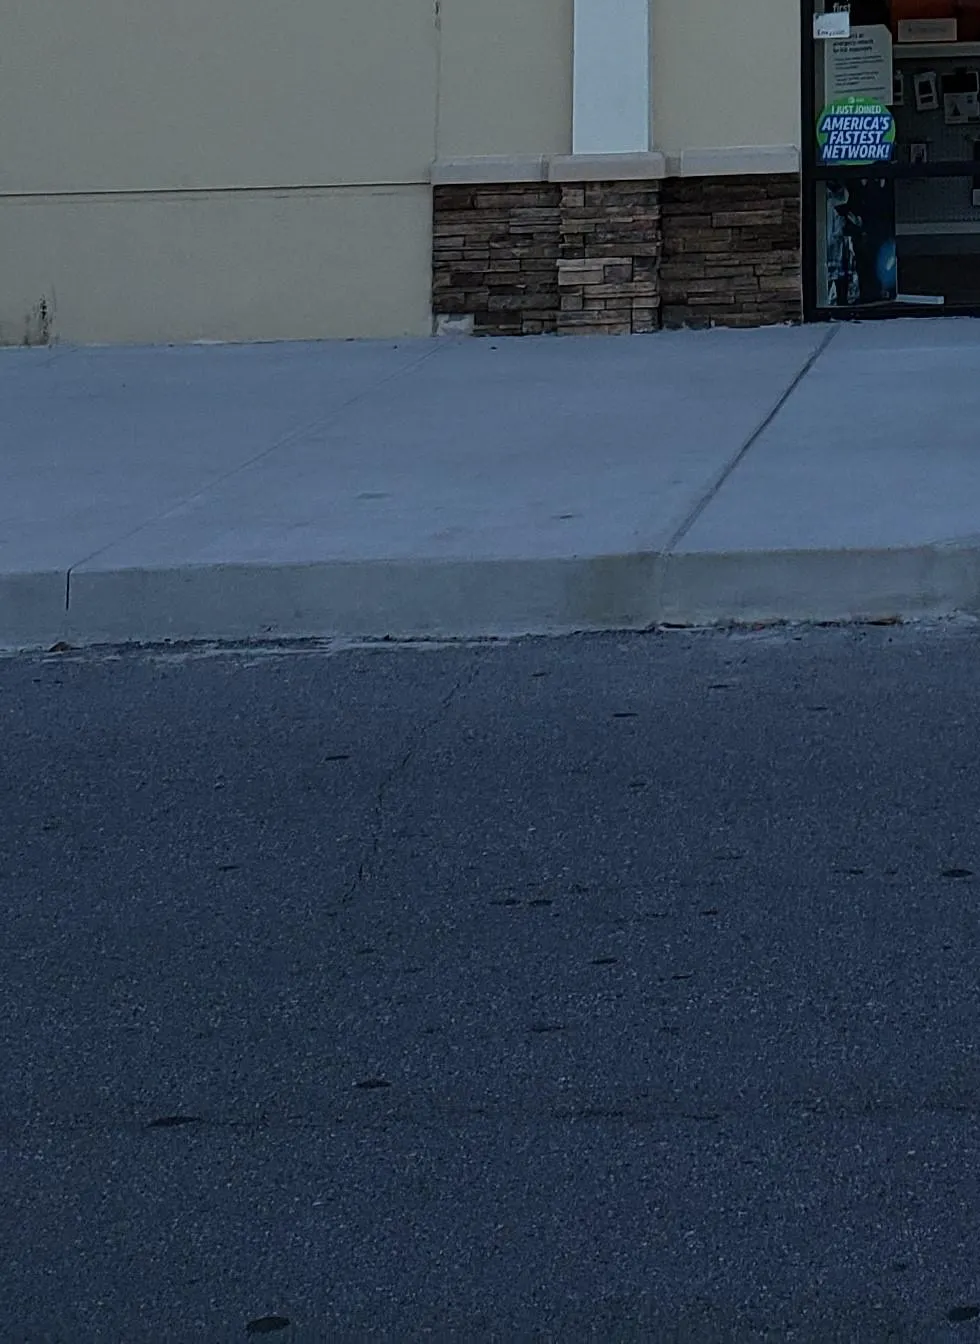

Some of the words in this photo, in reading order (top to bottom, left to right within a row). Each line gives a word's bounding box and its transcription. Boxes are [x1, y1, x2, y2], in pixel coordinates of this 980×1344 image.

[833, 2, 852, 12] first
[836, 105, 853, 114] JUST
[854, 105, 881, 114] JOINED
[821, 116, 890, 131] AMERICA'S
[829, 131, 884, 145] FASTEST
[822, 144, 890, 159] NETWORK!
